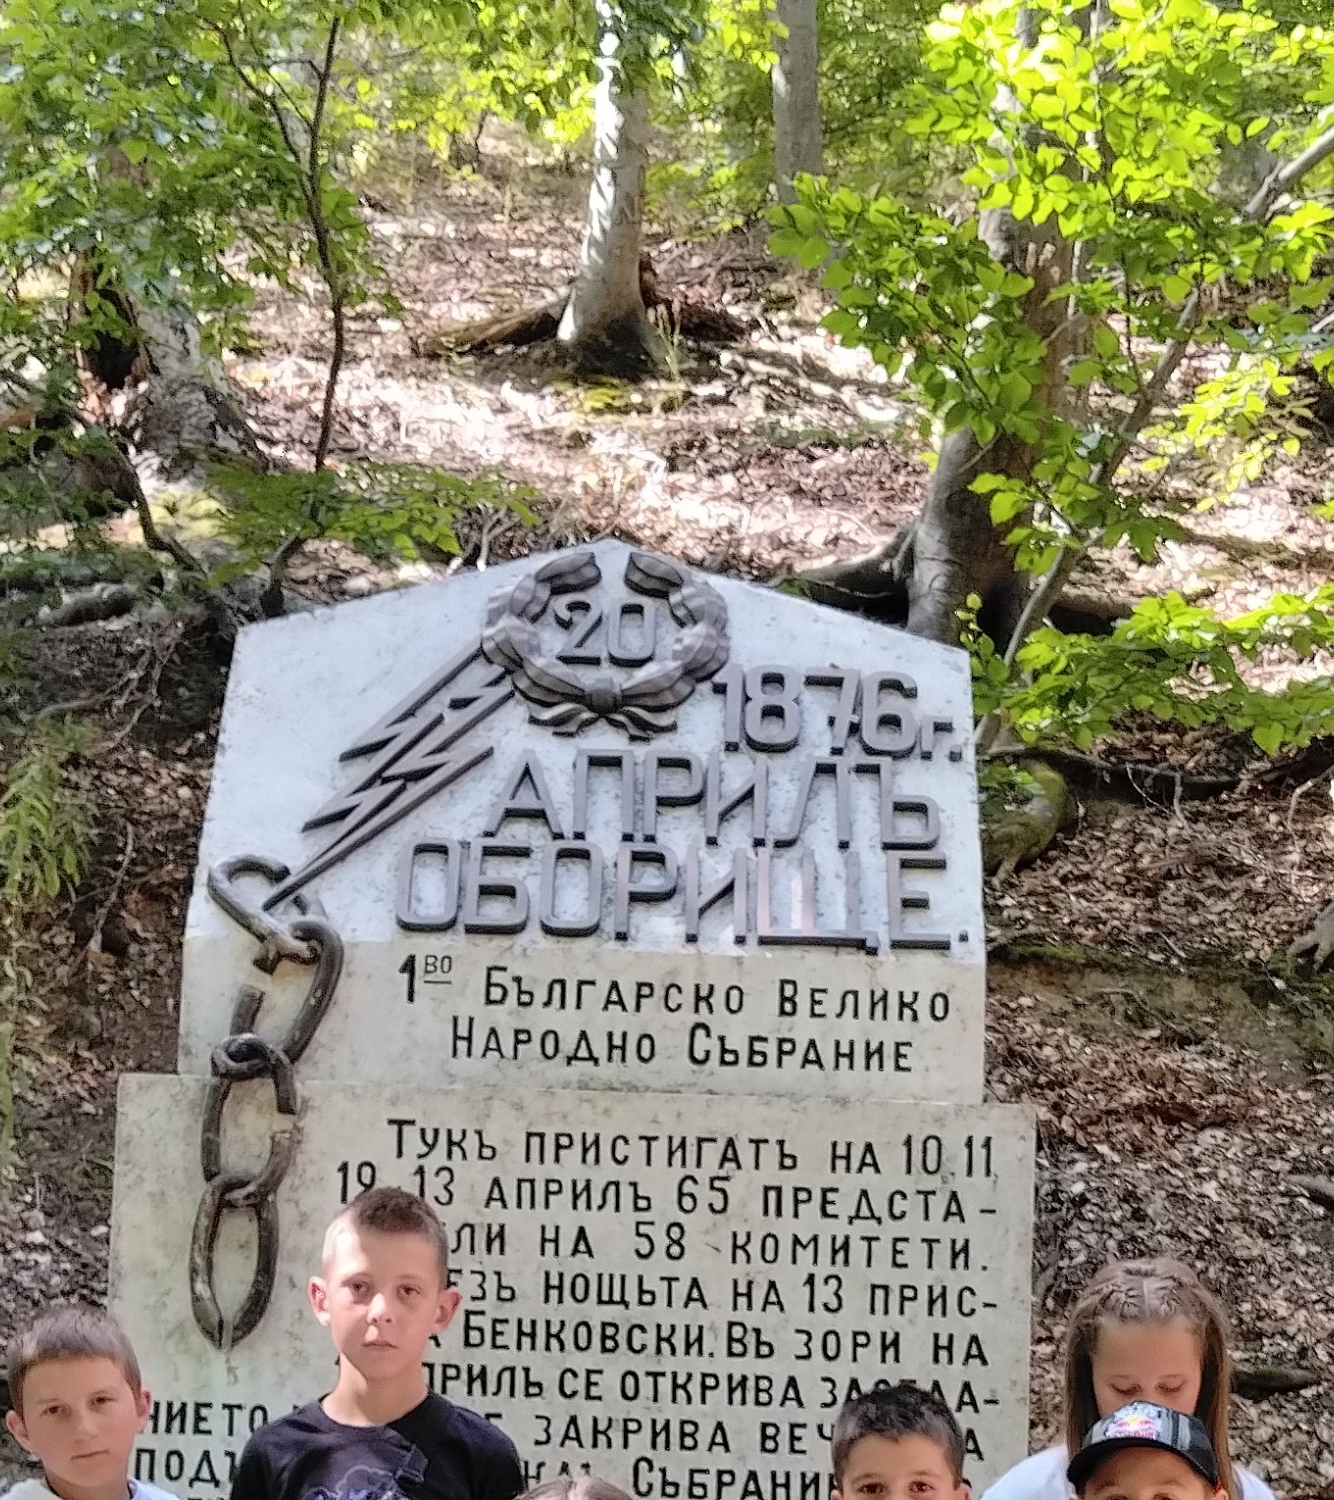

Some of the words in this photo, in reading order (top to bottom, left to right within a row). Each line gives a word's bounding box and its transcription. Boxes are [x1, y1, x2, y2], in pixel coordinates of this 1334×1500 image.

[554, 598, 657, 668] 20
[482, 750, 941, 852] АПРИЛЪ
[394, 839, 969, 955] ОБОРИЩЕ.
[525, 1131, 798, 1171] ПРИСТИГАТЪ
[830, 1140, 881, 1174] НА
[484, 1176, 652, 1213] АПРИЛЪ
[677, 1174, 732, 1215] 65
[762, 1184, 997, 1226] ПРЕДСТА-
[540, 1224, 595, 1259] НА
[634, 1220, 686, 1261] 58
[731, 1230, 988, 1271] КОМИТЕТИ.
[732, 1278, 785, 1313] НА
[803, 1272, 843, 1314] 13
[869, 1283, 998, 1318] ПРИС-
[463, 1309, 715, 1358] БЕНКОВСКИ.
[726, 1320, 775, 1360] ВЪ
[794, 1328, 901, 1365] ЗОРИ
[932, 1332, 989, 1367] НА
[558, 1367, 604, 1402] СЕ
[620, 1369, 805, 1409] ОТКРИВА
[533, 1414, 732, 1454] ЗАКРИВА
